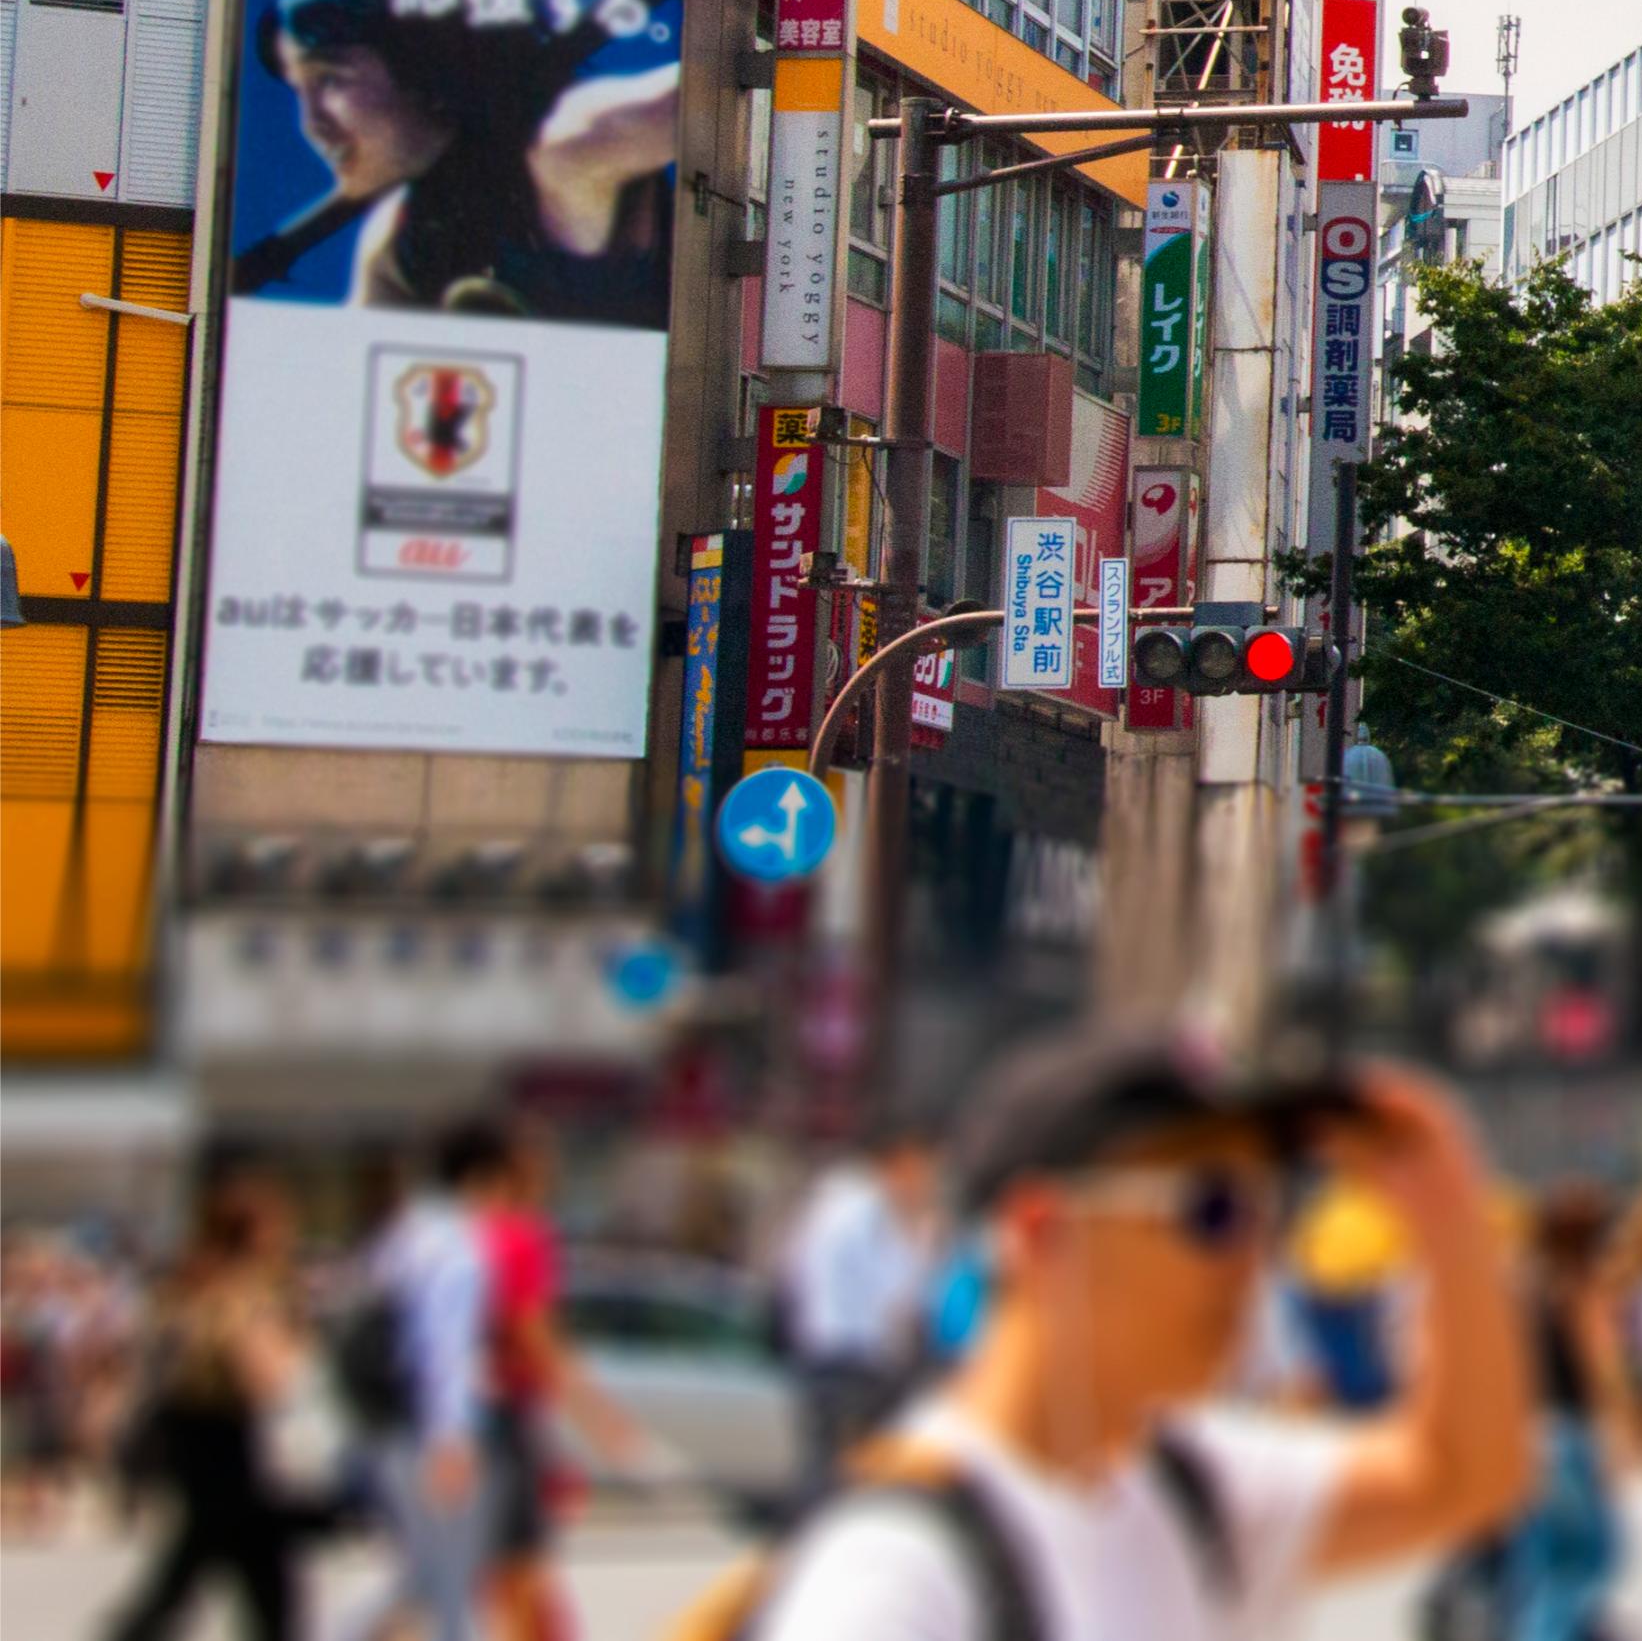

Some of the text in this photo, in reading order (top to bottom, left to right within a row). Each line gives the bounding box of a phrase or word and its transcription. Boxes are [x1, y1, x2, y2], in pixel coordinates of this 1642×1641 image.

[778, 20, 843, 47] 美容室
[811, 129, 832, 236] studio
[776, 178, 796, 295] new york
[1325, 219, 1369, 299] OS
[1150, 282, 1184, 375] レイク
[1322, 303, 1362, 445] 調剤薬局
[777, 413, 809, 446] 薬
[1155, 413, 1182, 433] 3F
[216, 594, 640, 649] auはサッカー日本代表を
[761, 502, 807, 722] サンドラッグ
[1013, 553, 1033, 655] Shibuya Sta.
[1033, 531, 1065, 674] 渋谷駅前
[1104, 566, 1121, 681] スクランブル式
[301, 645, 568, 698] 応援しています。
[1140, 688, 1166, 705] 3F
